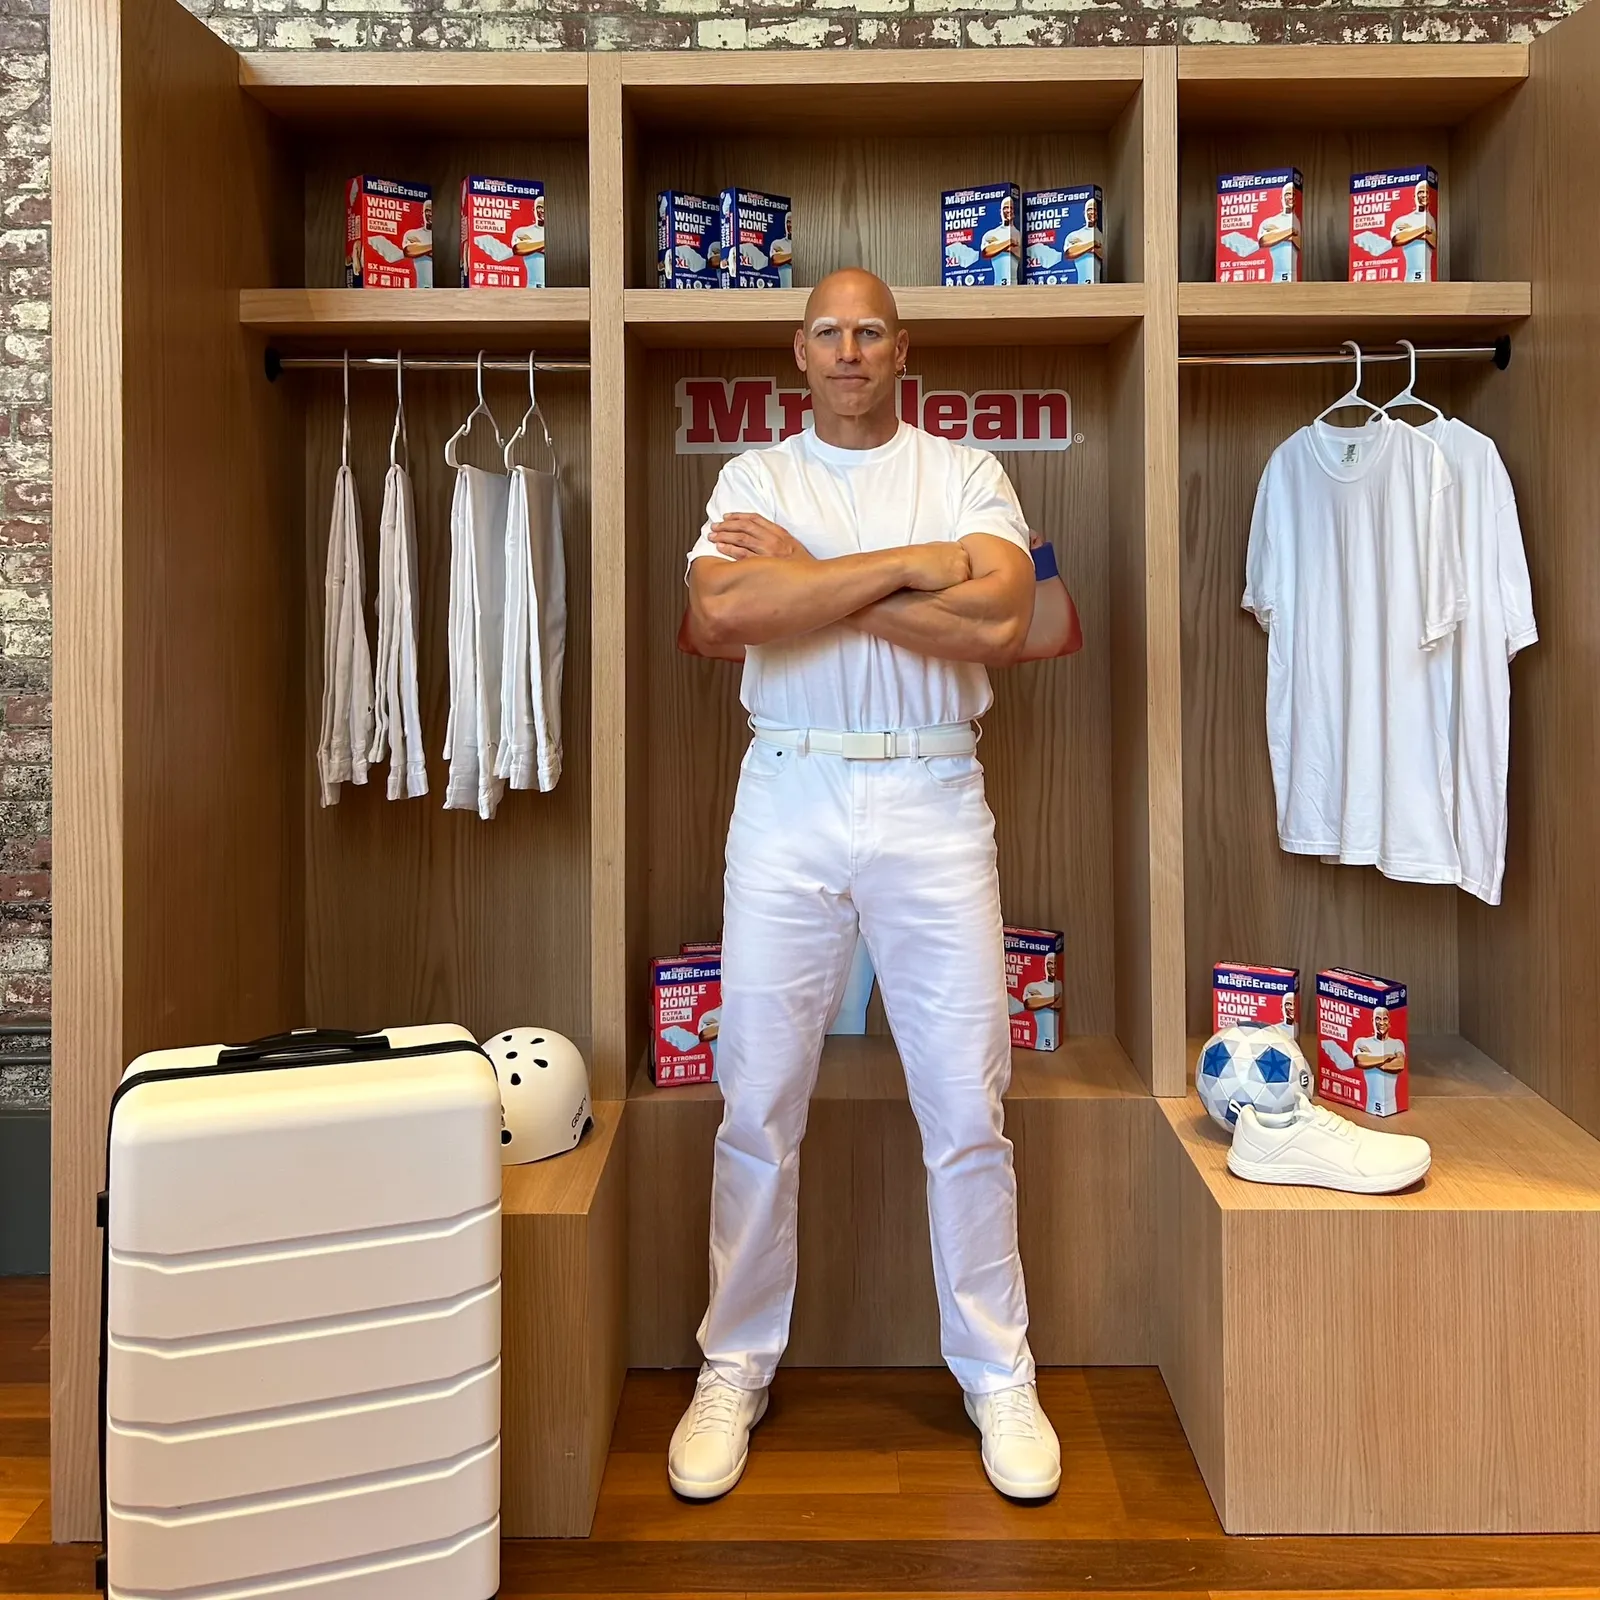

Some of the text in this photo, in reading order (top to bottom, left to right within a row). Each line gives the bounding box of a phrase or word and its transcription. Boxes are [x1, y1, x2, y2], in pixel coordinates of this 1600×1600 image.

[366, 196, 410, 212] WHOLE
[473, 196, 520, 210] WHOLE
[1221, 191, 1267, 205] WHOLE
[1353, 190, 1400, 205] WHOLE
[367, 206, 402, 221] HOME
[473, 206, 511, 219] HOME
[739, 208, 773, 223] WHOLE
[945, 206, 986, 220] WHOLE
[1026, 207, 1069, 222] WHOLE
[1221, 203, 1258, 216] HOME
[1353, 202, 1391, 216] HOME
[674, 211, 712, 226] WHOLE
[739, 219, 767, 232] HOME
[945, 217, 978, 231] HOME
[1026, 218, 1061, 231] HOME
[675, 221, 705, 234] HOME
[676, 257, 688, 269] XL
[740, 255, 752, 266] XL
[945, 257, 960, 267] XL
[1026, 257, 1041, 268] XL
[900, 379, 1067, 440] lean
[1006, 965, 1023, 975] ME
[660, 984, 706, 998] WHOLE
[660, 996, 698, 1009] HOME
[1217, 991, 1267, 1007] WHOLE
[1217, 1002, 1257, 1016] HOME
[1319, 998, 1360, 1018] WHOLE
[662, 1014, 690, 1022] DURABLE
[1320, 1009, 1353, 1027] HOME
[1321, 1022, 1339, 1032] EXTRA
[1321, 1027, 1346, 1039] DURABLE
[1375, 1102, 1381, 1111] 5
